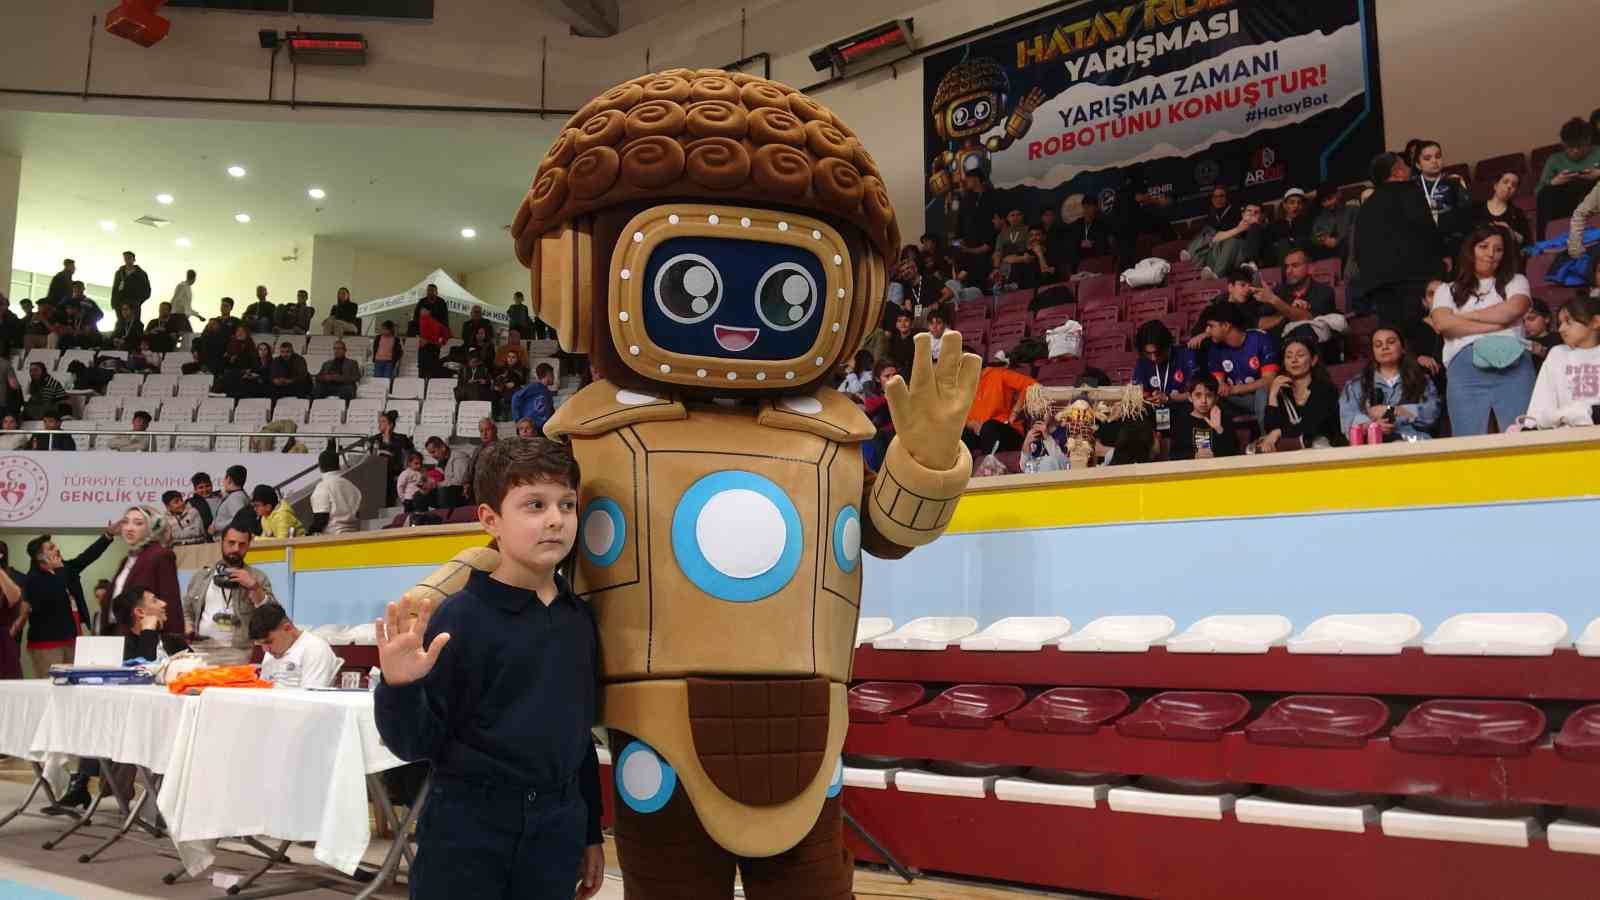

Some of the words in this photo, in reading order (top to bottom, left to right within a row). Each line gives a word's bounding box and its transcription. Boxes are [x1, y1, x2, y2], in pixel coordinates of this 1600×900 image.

[1016, 6, 1135, 69] HATAY
[1064, 9, 1240, 82] YARIŞMASI
[1028, 107, 1161, 160] ROBOTUNU
[1168, 64, 1328, 124] KONUŞTUR!
[1059, 82, 1167, 128] YARIŞMA
[1174, 49, 1280, 96] ZAMANI
[1245, 93, 1329, 123] #HatayBot
[60, 489, 131, 504] GENÇLİK
[133, 490, 156, 502] VE
[63, 474, 129, 487] TÜRKİYE
